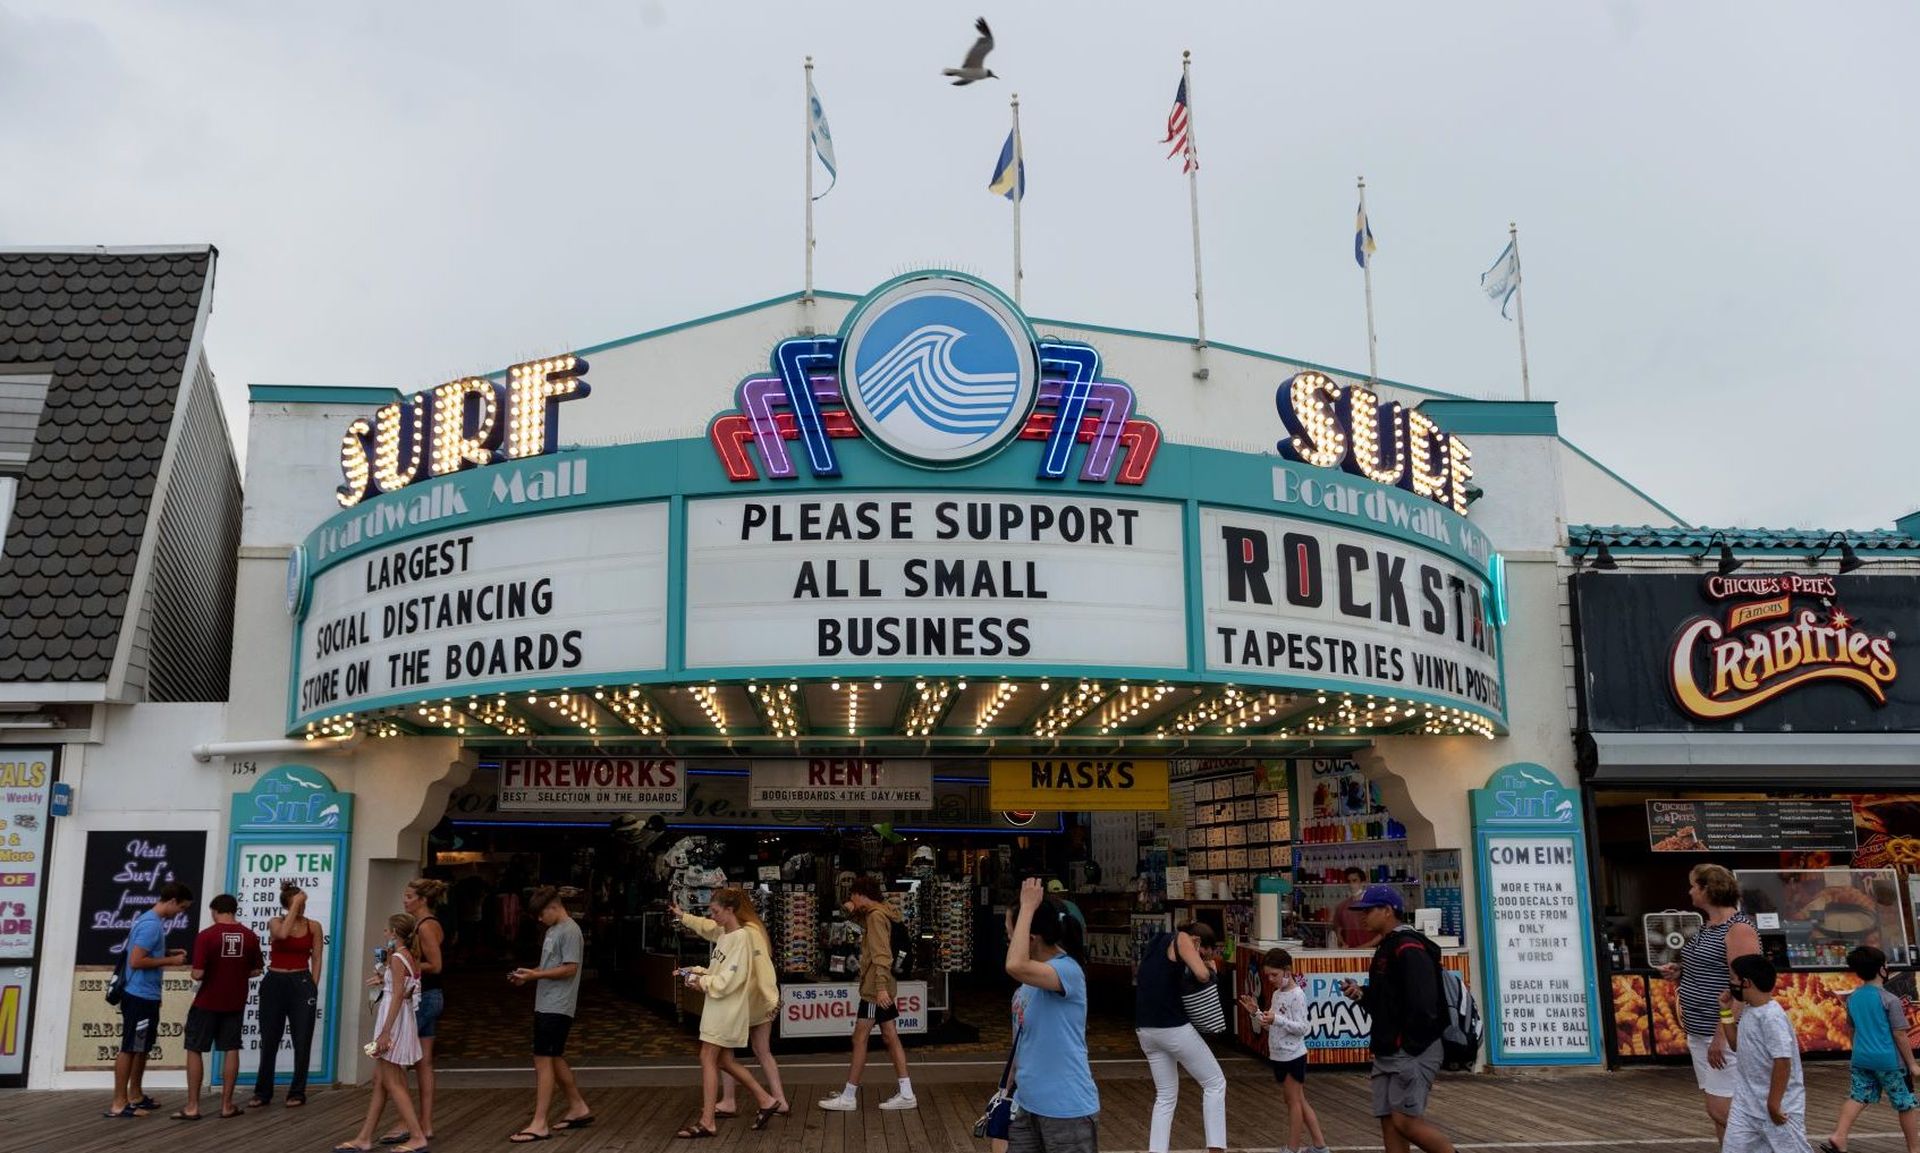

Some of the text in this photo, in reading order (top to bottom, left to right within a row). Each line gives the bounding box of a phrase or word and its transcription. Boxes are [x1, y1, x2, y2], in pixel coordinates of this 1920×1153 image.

[336, 353, 591, 509] SURF
[1276, 371, 1473, 518] SURF
[489, 459, 587, 509] Mall
[1272, 466, 1451, 545] Boardwalk
[741, 501, 1139, 545] PLEASE SUPPORT
[367, 537, 473, 594] LARGEST
[793, 558, 1048, 599] ALL SMALL
[1709, 577, 1780, 598] CHICKIE'S
[1792, 576, 1836, 596] PETE'S
[317, 578, 553, 659] SOCIAL DISTANCING
[819, 617, 1030, 656] BUSINESS
[1218, 627, 1404, 682] TAPESTRIES
[1412, 652, 1463, 695] VINYL
[302, 631, 583, 711] STORE ON THE BOARDS
[232, 761, 257, 775] 1154
[505, 760, 677, 787] FIREWORKS
[808, 760, 881, 786] RENT
[1031, 761, 1135, 789] MASKS
[6, 792, 43, 806] Weekly
[503, 792, 527, 801] BEST
[538, 792, 592, 801] SELECTION
[597, 792, 610, 801] ON
[615, 792, 632, 801] THE
[640, 792, 678, 802] BOARDS
[762, 790, 921, 800] BOOGIEBOARDS 4 THE DAY/WEEK
[1496, 790, 1558, 817] Surf
[252, 794, 326, 823] Surf
[127, 840, 166, 858] Visit
[1490, 847, 1572, 865] COME IN!
[246, 854, 332, 873] TOP TEN
[3, 876, 27, 885] OF
[113, 862, 175, 890] Surf's
[253, 878, 275, 888] POP
[1501, 883, 1562, 892] MORE THAN
[119, 890, 161, 911] famou
[253, 893, 274, 902] CBD
[1520, 897, 1559, 906] DECALS
[1562, 897, 1574, 905] TO
[1495, 910, 1568, 919] CHOOSE FROM
[1519, 925, 1545, 934] ONLY
[1508, 938, 1568, 947] AT TSHIRT
[1518, 952, 1554, 961] WORLD
[1510, 980, 1569, 989] BEACH FUN
[793, 990, 817, 999] $6.95
[824, 989, 848, 998] $9.95
[1552, 994, 1587, 1003] INSIDE
[1505, 1008, 1586, 1017] FROM CHAIRS
[899, 1018, 918, 1027] PAIR
[1503, 1022, 1588, 1032] TO SPIKE BALL
[1504, 1037, 1516, 1046] WE
[1521, 1037, 1549, 1046] HAVE
